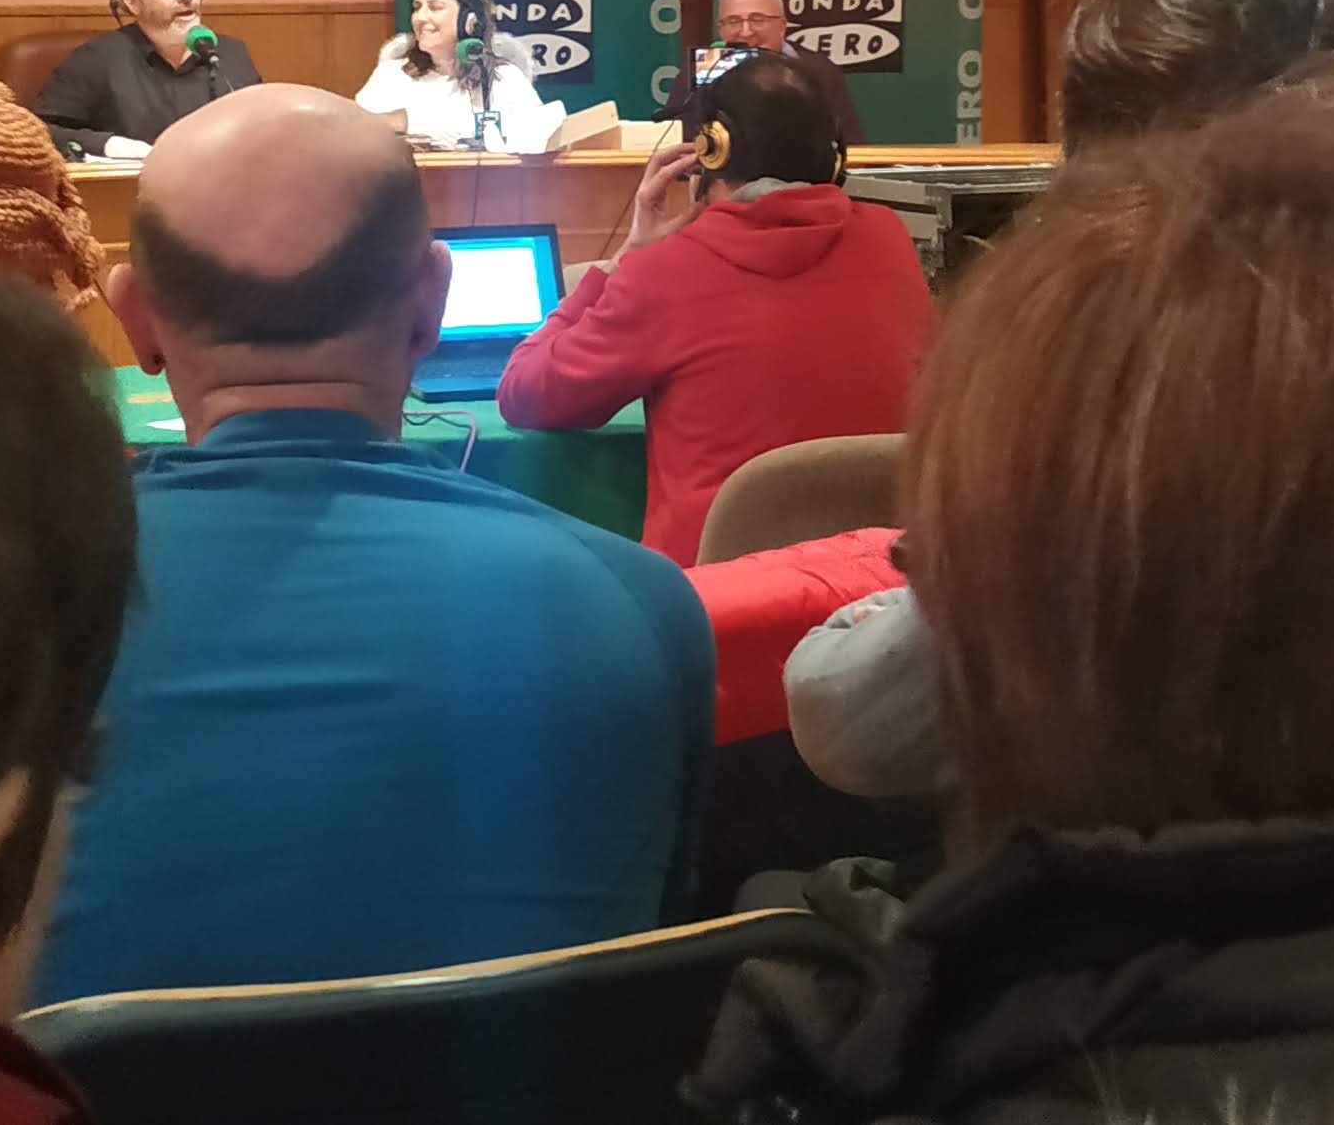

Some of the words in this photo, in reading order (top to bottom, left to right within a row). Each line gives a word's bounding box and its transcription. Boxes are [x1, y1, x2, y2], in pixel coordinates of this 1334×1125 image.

[496, 3, 571, 21] NDA
[532, 44, 571, 66] RO
[957, 49, 982, 147] ERO
